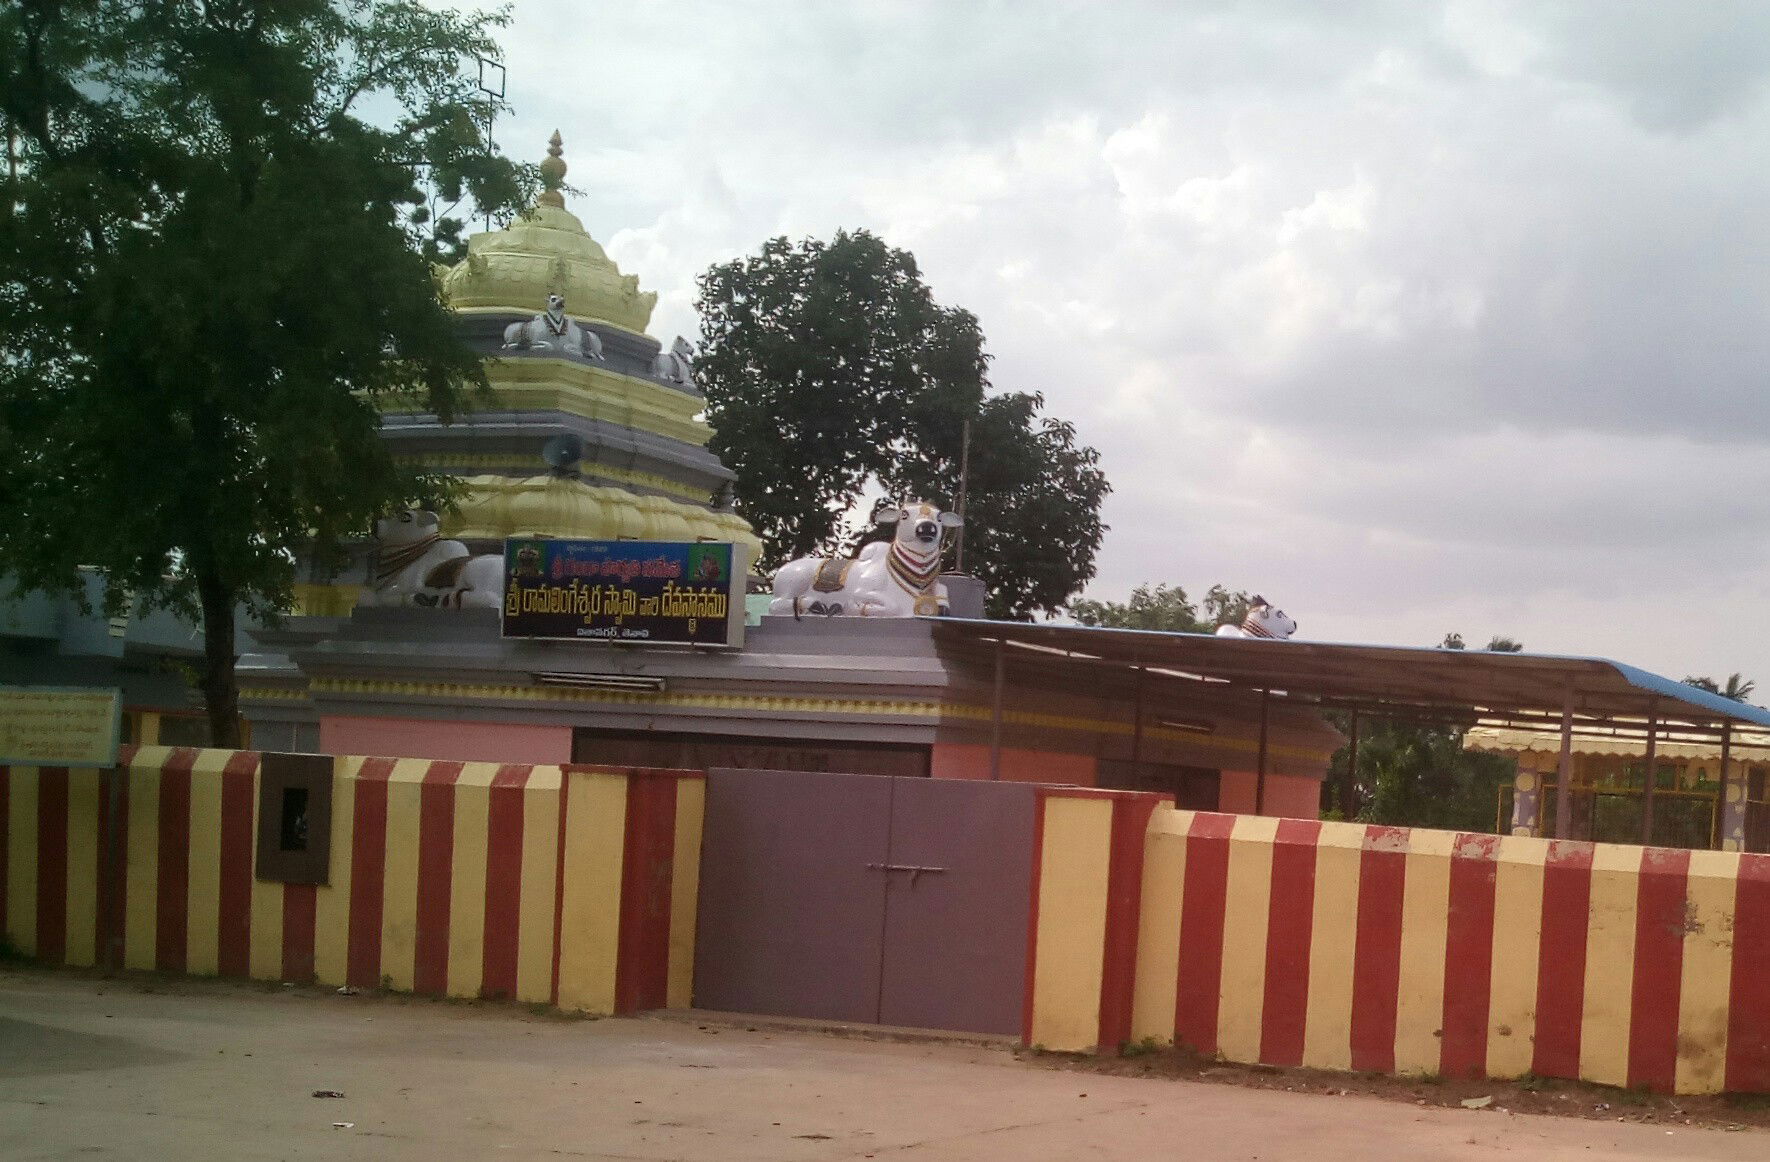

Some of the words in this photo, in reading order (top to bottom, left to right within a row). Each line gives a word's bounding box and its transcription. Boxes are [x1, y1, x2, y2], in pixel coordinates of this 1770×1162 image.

[505, 578, 520, 616] శ్రీ
[523, 578, 602, 624] రామలింగేశ్వర
[604, 584, 637, 626] స్వామి
[639, 596, 659, 617] వారి
[661, 579, 726, 634] దేవస్థానము
